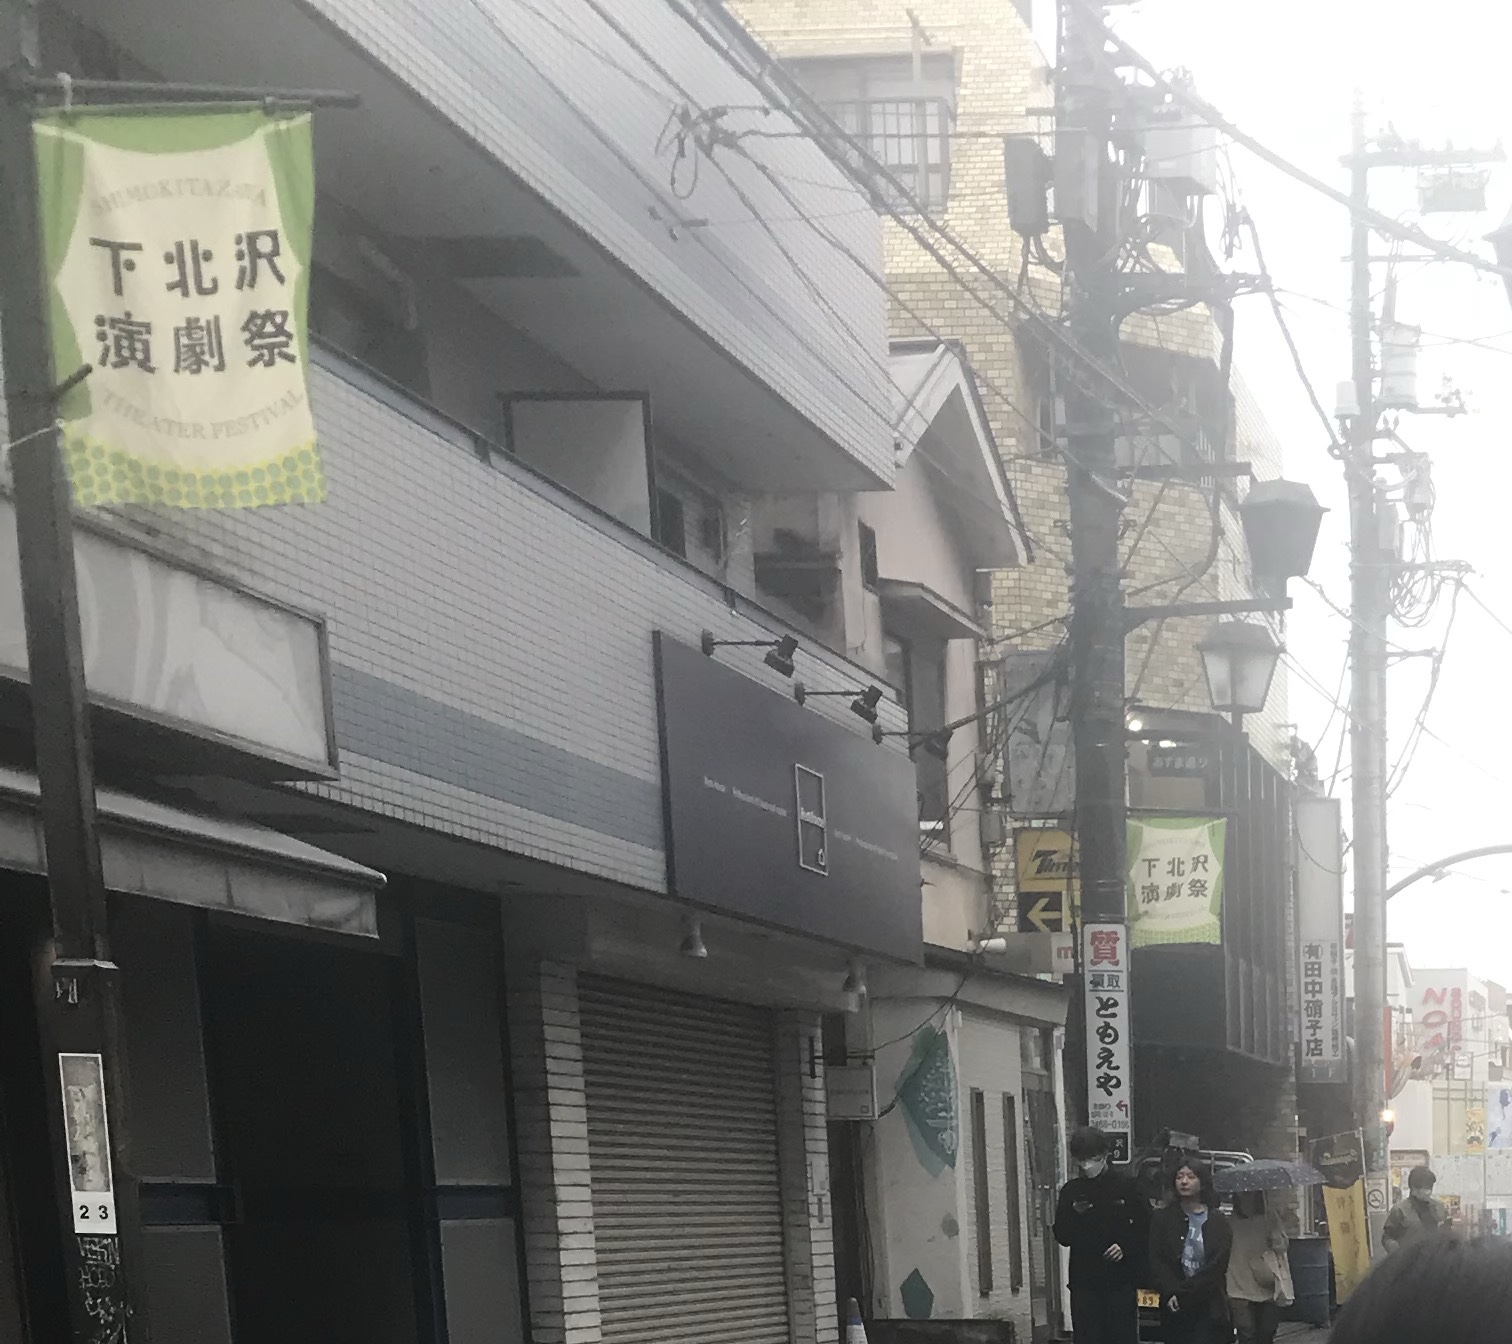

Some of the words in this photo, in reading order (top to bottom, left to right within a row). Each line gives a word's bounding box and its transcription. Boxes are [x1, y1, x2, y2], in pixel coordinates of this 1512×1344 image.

[89, 229, 286, 297] 下北沢
[94, 309, 297, 375] 演劇祭
[1141, 854, 1208, 878] 下北沢
[1141, 879, 1208, 904] 演劇祭
[1090, 930, 1120, 966] 質
[1096, 996, 1122, 1097] ともえや
